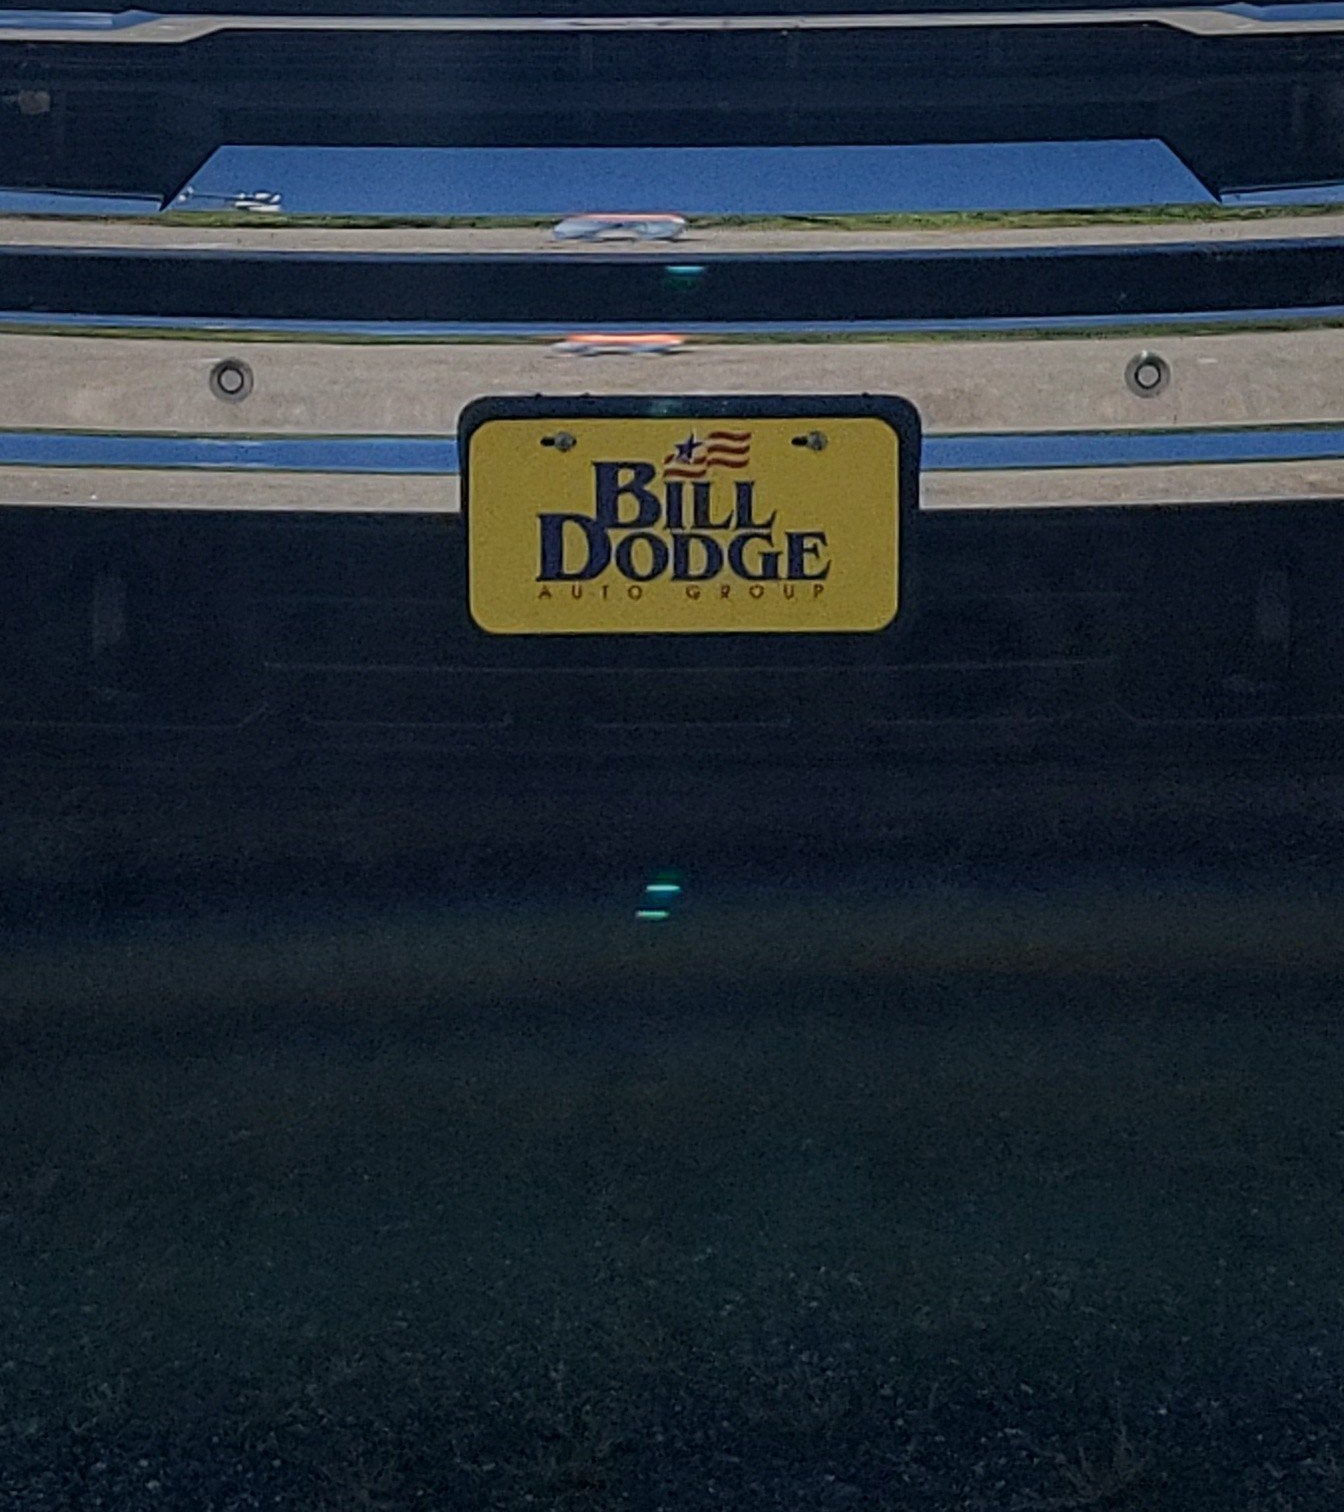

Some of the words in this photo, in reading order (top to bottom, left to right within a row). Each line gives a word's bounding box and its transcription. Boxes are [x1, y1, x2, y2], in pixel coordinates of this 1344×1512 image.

[591, 460, 777, 530] BILL
[535, 512, 832, 582] DODGE
[537, 584, 644, 601] AUTO
[685, 584, 827, 601] GROUP
